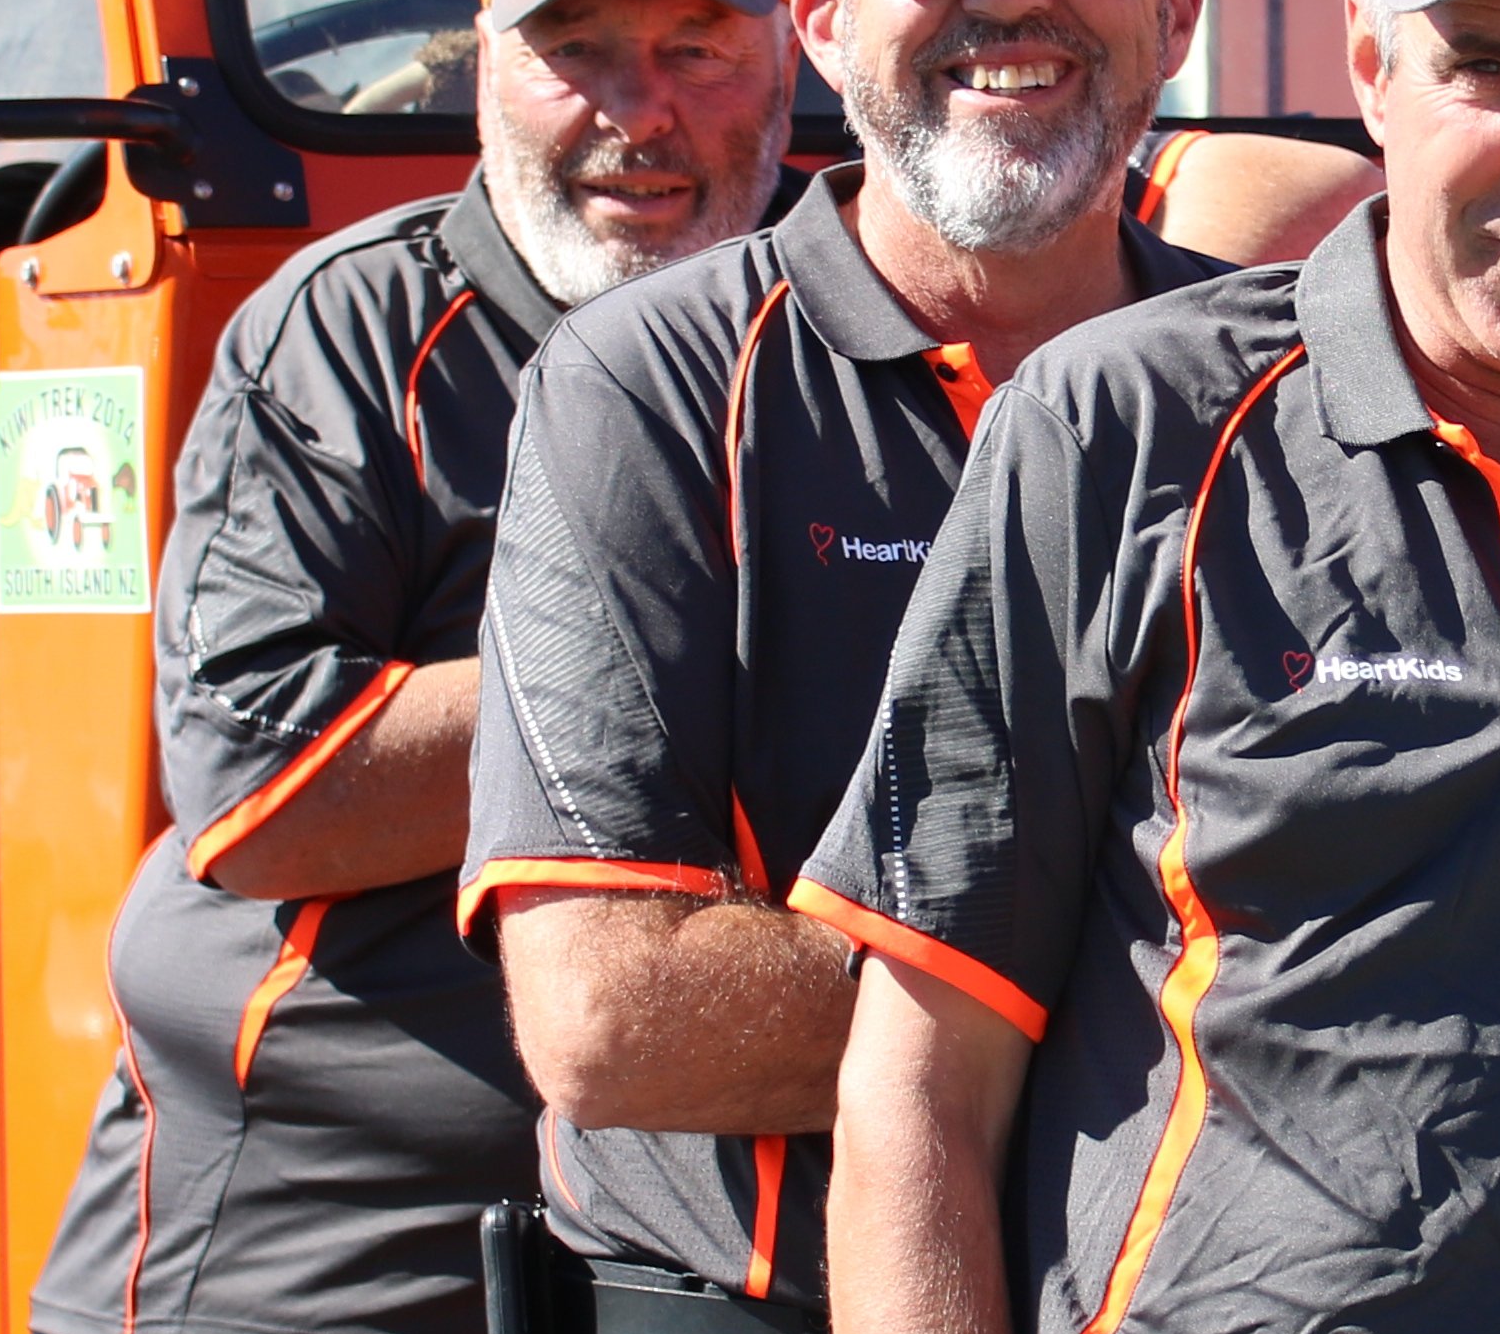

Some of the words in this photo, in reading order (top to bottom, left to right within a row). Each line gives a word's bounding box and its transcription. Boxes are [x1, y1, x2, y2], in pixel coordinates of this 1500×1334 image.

[40, 386, 86, 421] TREK
[92, 391, 136, 446] 2014
[4, 568, 54, 596] SOUTH
[58, 568, 114, 596] ISLAND
[118, 568, 138, 596] NZ
[1315, 656, 1463, 684] HeartKids
